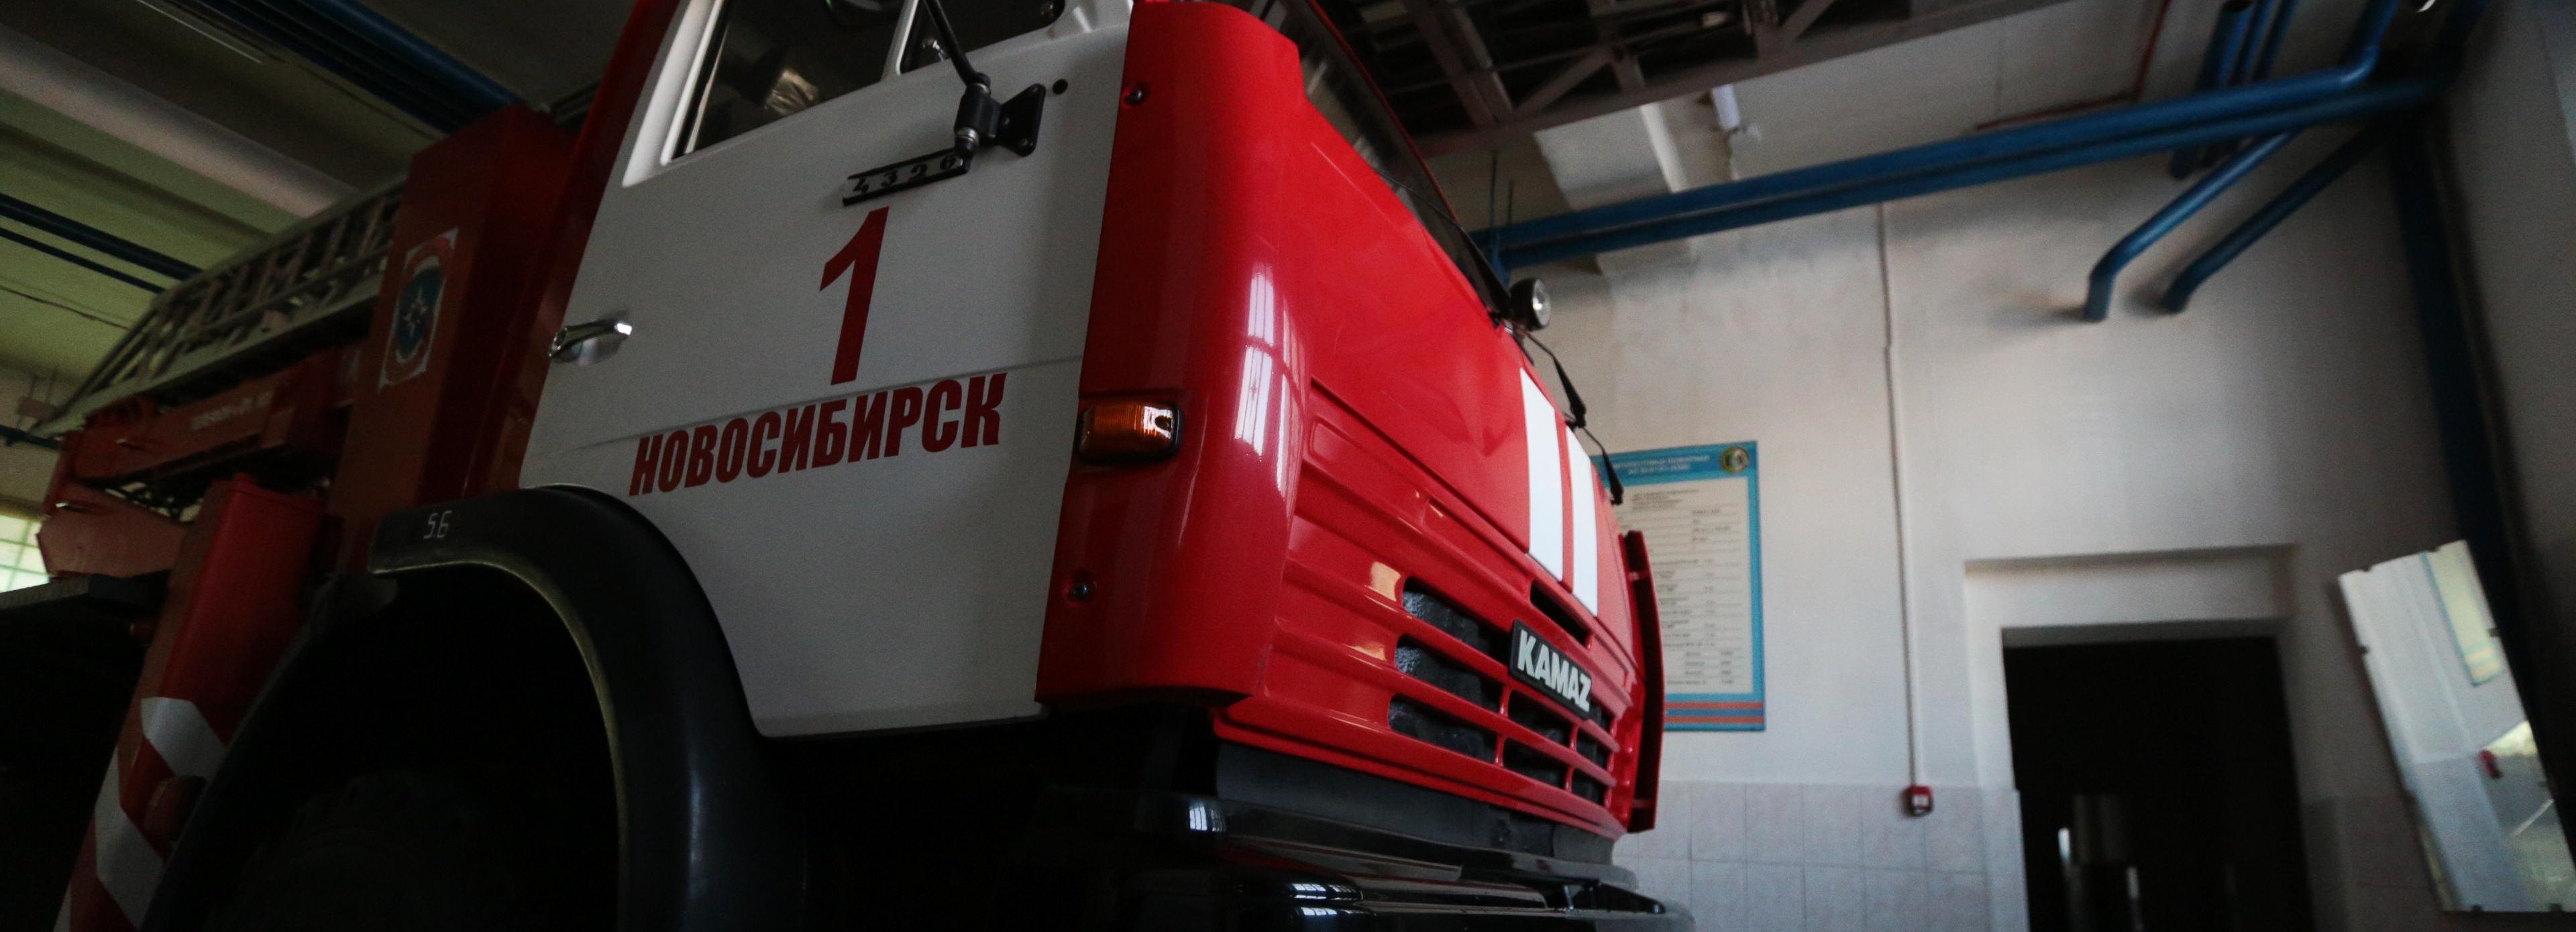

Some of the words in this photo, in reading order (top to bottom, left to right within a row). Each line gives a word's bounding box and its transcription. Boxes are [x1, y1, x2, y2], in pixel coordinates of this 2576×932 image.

[820, 206, 889, 385] 1
[629, 373, 1007, 496] НОВОСИБИРСК
[1517, 630, 1592, 712] KAMAZ
